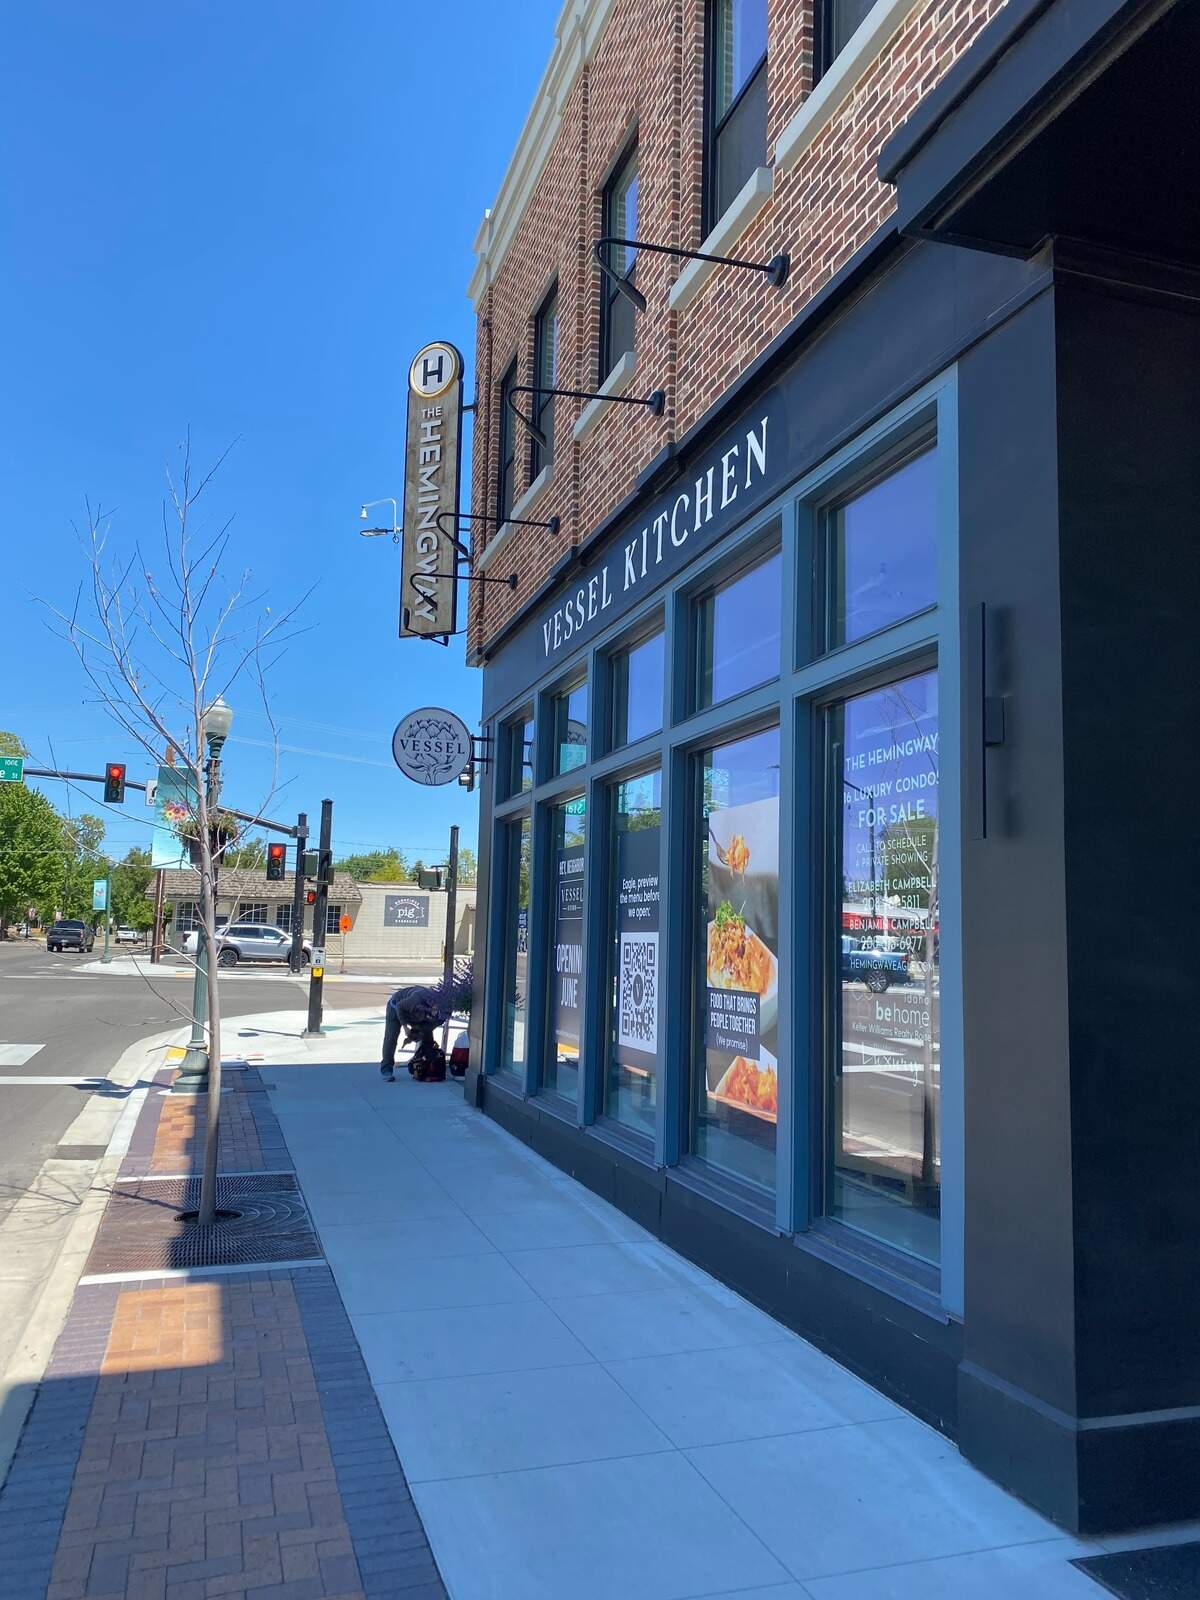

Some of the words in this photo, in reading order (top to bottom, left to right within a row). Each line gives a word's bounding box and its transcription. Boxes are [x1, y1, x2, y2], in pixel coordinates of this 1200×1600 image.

[422, 354, 444, 386] H
[421, 405, 443, 418] THE
[414, 418, 442, 624] HEMINGWAY
[542, 566, 612, 657] VESSEL
[623, 416, 769, 592] KITCHEN
[400, 738, 466, 755] VESSEL
[845, 753, 865, 772] THE
[868, 732, 940, 765] HEMINGWAY
[854, 780, 893, 803] LUXURY
[858, 807, 887, 829] FOR
[889, 799, 926, 823] SALE
[856, 841, 874, 854] CALL
[876, 840, 886, 851] TO
[887, 834, 927, 850] SCHEDULE
[891, 850, 928, 865] SHOWING
[637, 874, 659, 892] preview
[848, 879, 890, 893] ELIZABETH
[892, 875, 937, 890] CAMPBELL
[561, 887, 584, 903] VESSEL
[397, 906, 415, 919] pig
[891, 917, 936, 930] CAMPBELL
[560, 977, 578, 1008] JUNE
[710, 992, 723, 1009] FOOD
[723, 994, 737, 1011] THAT
[736, 996, 757, 1014] BRINGS
[710, 1012, 729, 1030] PEOPLE
[729, 1014, 756, 1035] TOGETHER
[726, 1037, 748, 1052] promise)
